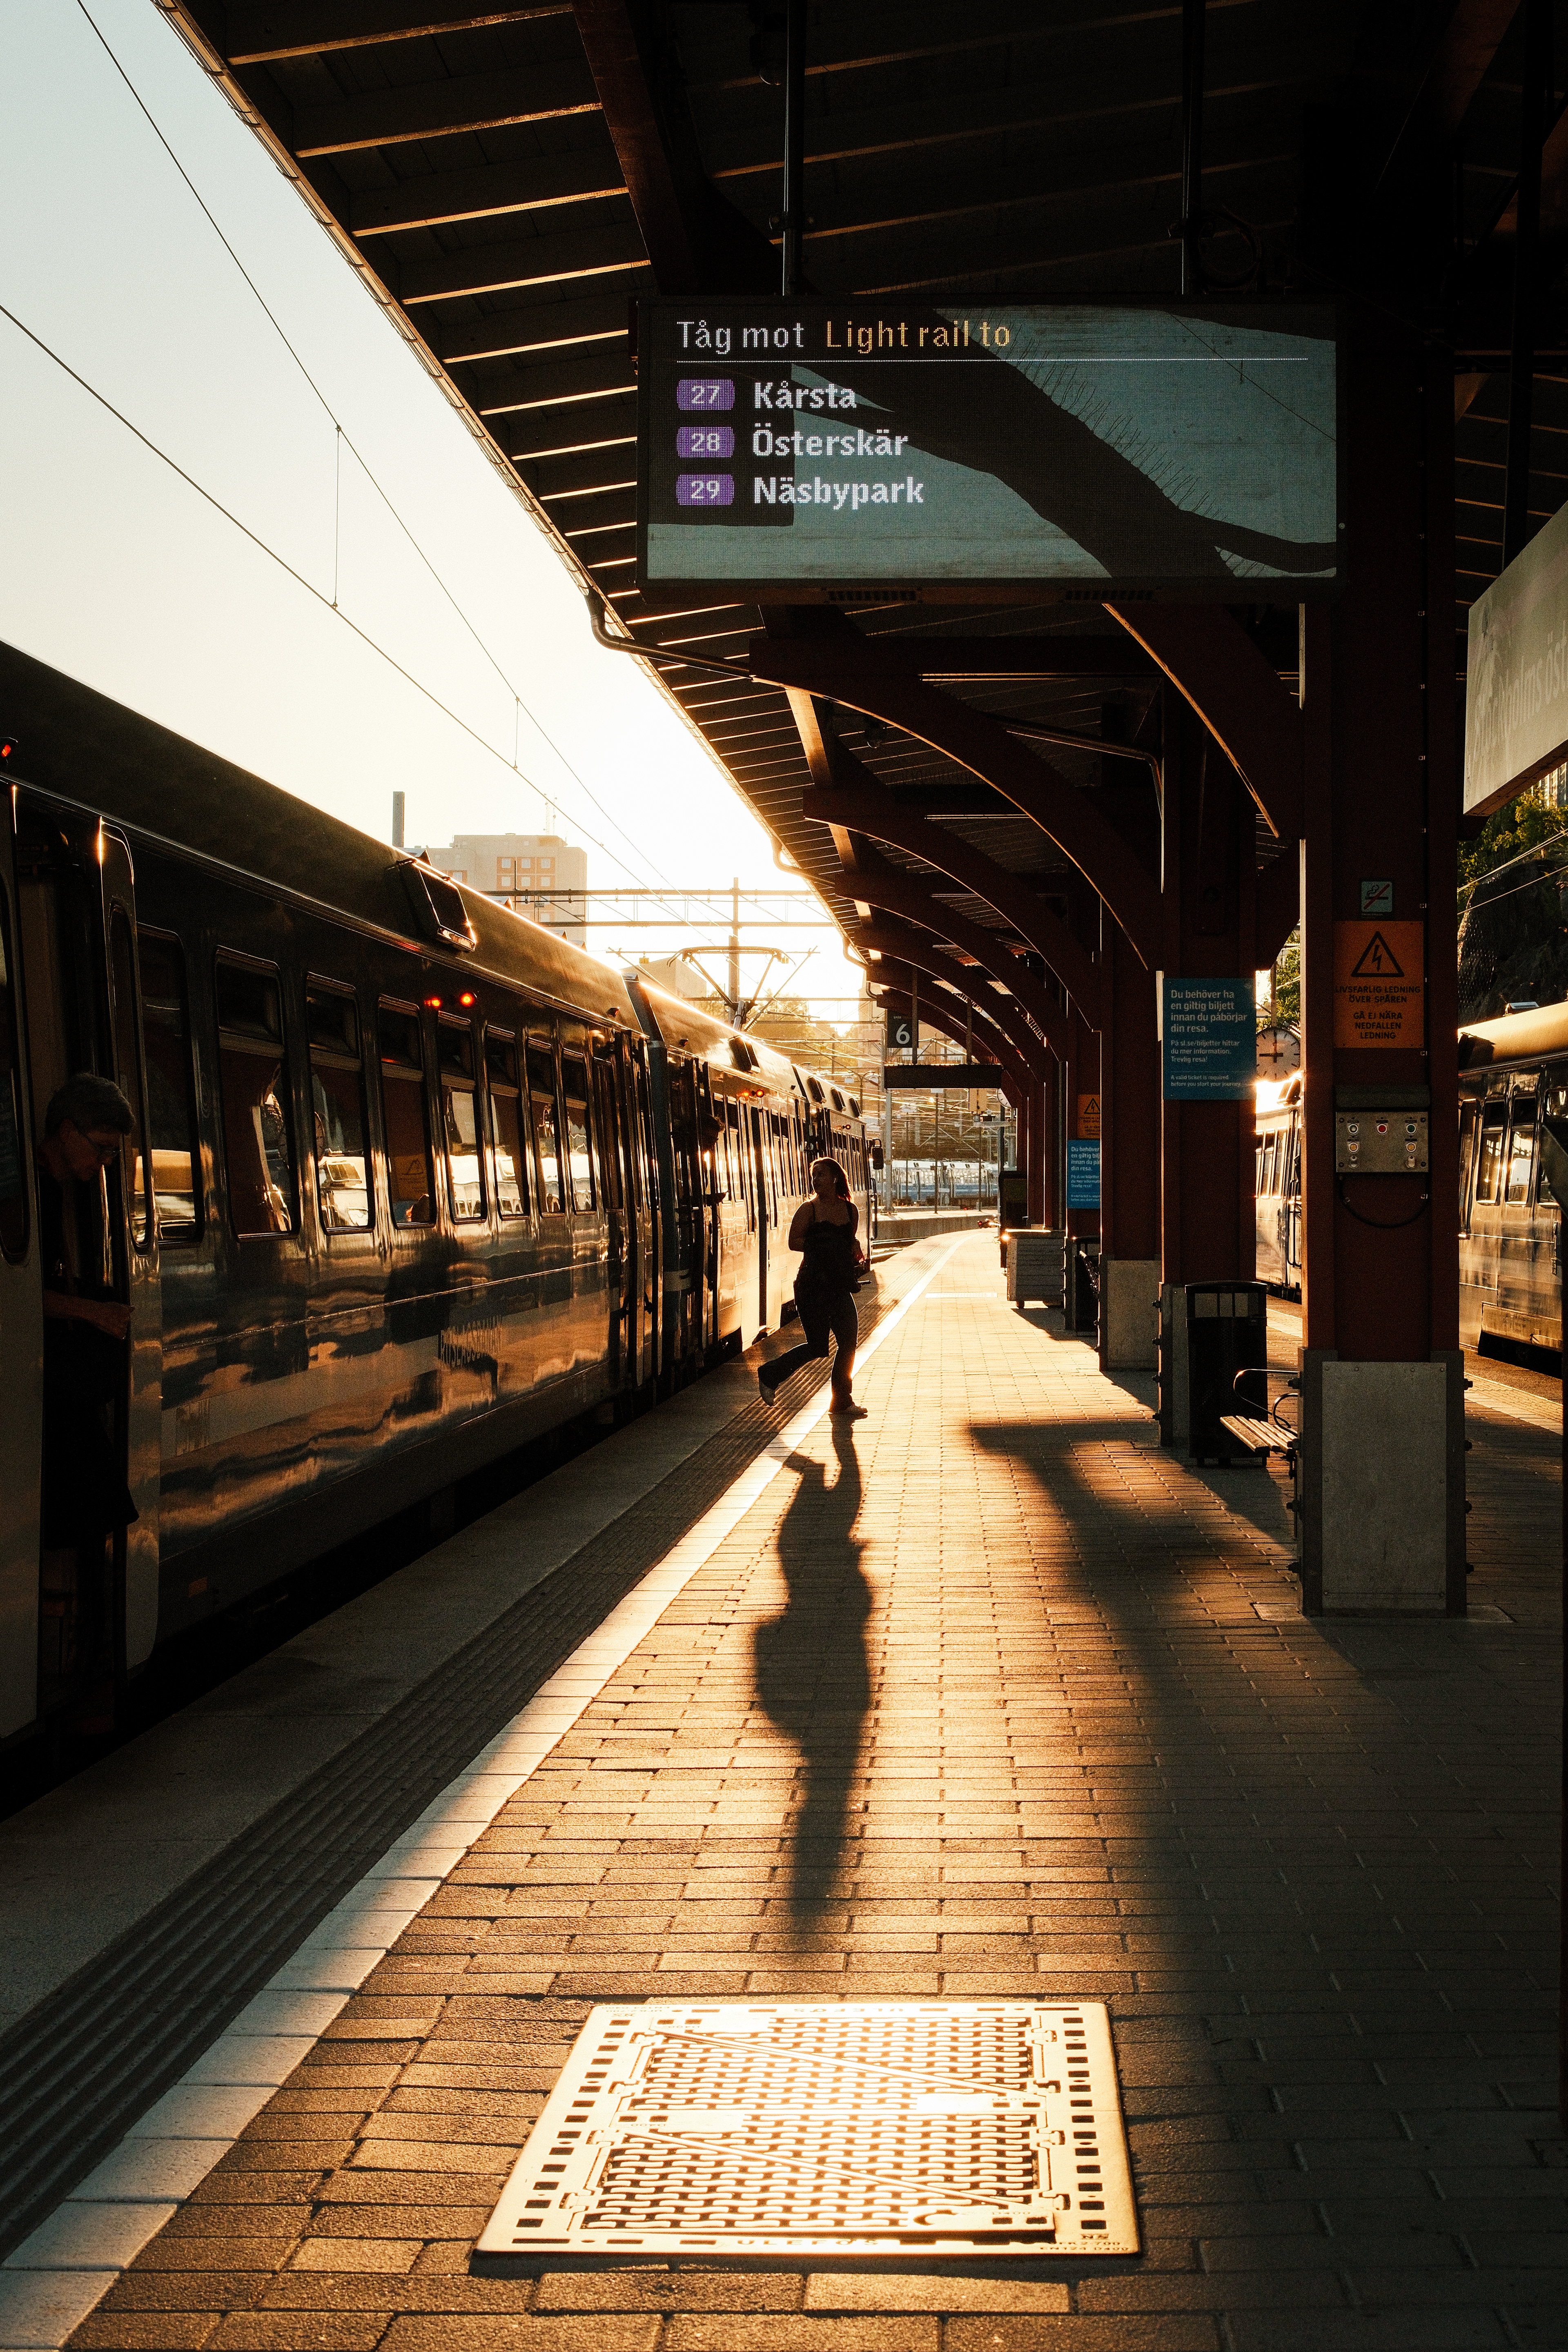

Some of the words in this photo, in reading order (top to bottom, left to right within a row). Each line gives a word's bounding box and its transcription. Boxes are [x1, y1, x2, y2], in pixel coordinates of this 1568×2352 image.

[677, 320, 731, 354] Tåg
[742, 324, 805, 349] mot
[825, 320, 909, 354] Light
[918, 320, 969, 349] rail
[981, 324, 1011, 349] to
[691, 385, 720, 405] 27
[754, 381, 857, 410] Kårsta
[691, 432, 720, 452] 28
[752, 423, 909, 457] Österskär
[691, 480, 720, 500] 29
[753, 475, 924, 510] Näsbypark
[1546, 620, 1568, 705] öst
[1171, 990, 1183, 998] Du
[1185, 990, 1221, 998] behöver
[1224, 990, 1234, 998] ha
[1349, 995, 1371, 1003] ÖVER
[1374, 994, 1407, 1003] SPÅREN
[1184, 1001, 1206, 1011] giltig
[1209, 1001, 1234, 1011] biljett
[1197, 1013, 1208, 1021] du
[1210, 1013, 1247, 1022] påbörjar
[1354, 1011, 1365, 1019] GÅ
[1379, 1011, 1403, 1019] NÄRA
[896, 1023, 910, 1044] 6
[1171, 1024, 1184, 1032] din
